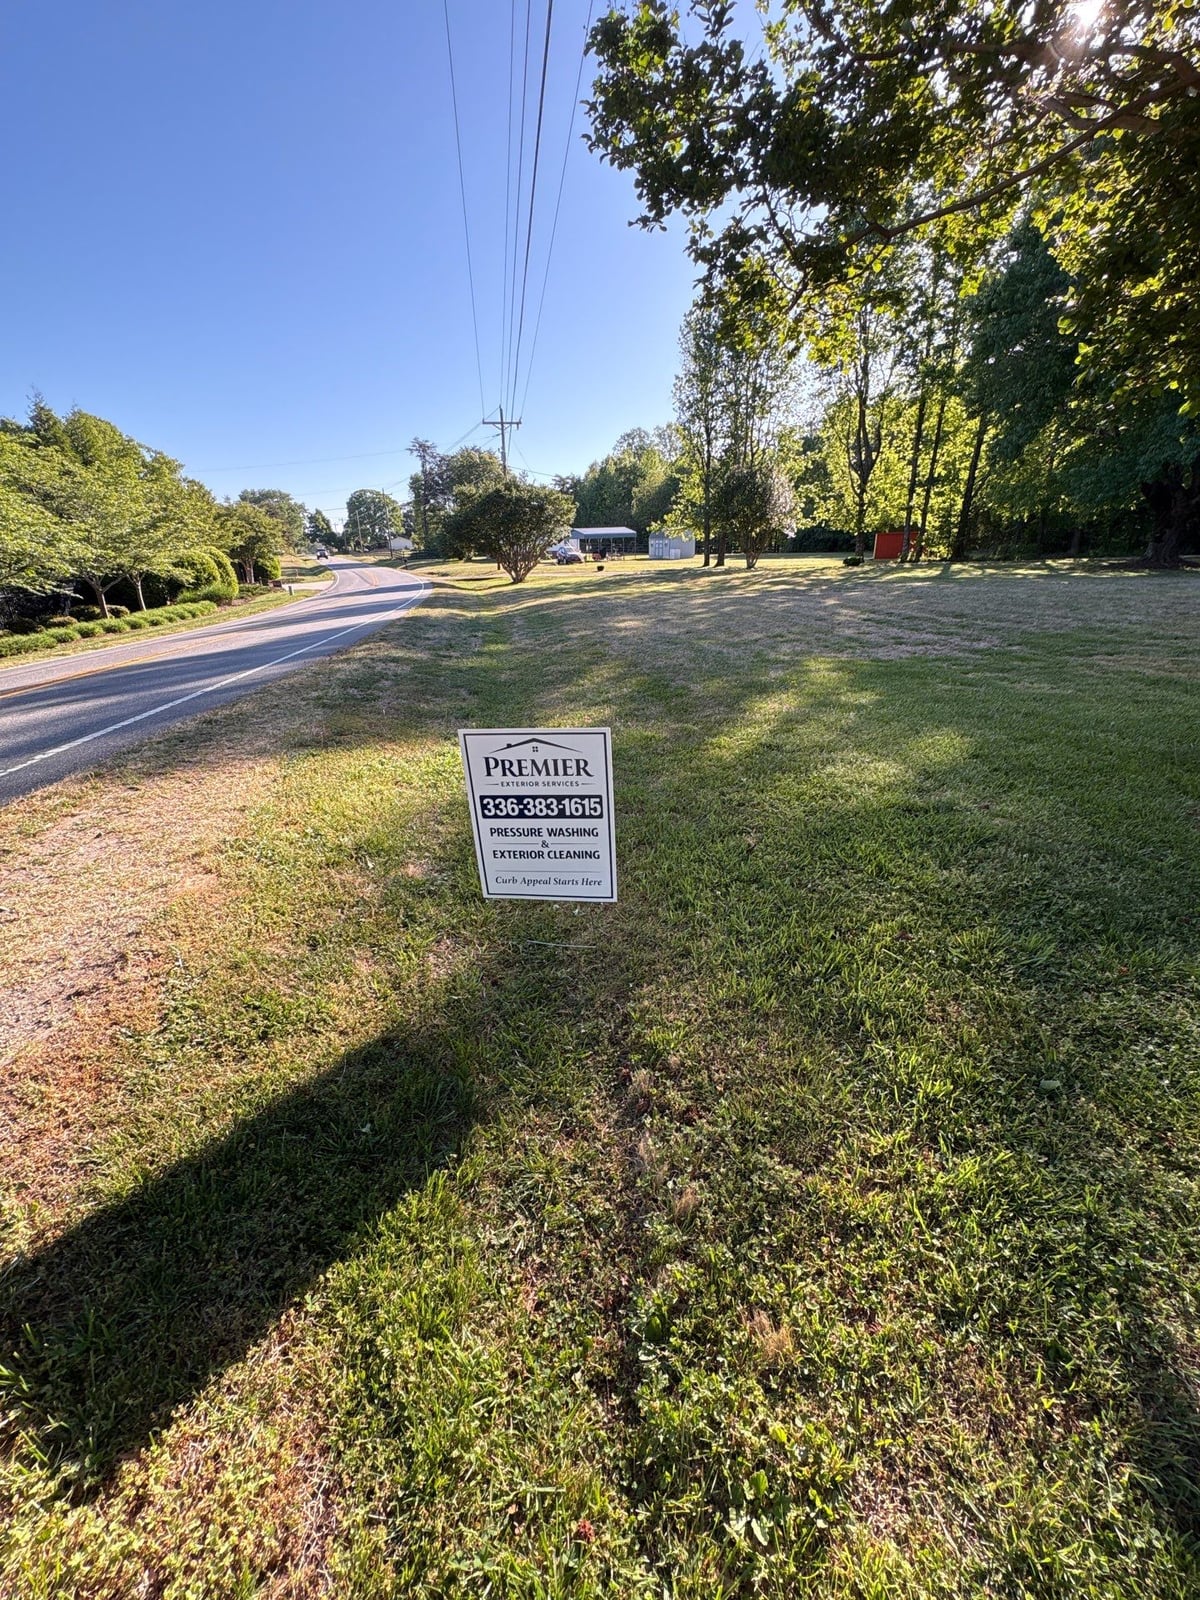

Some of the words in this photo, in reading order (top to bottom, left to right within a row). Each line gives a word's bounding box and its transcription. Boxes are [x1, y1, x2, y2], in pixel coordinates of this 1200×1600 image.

[483, 756, 595, 778] PREMIER
[482, 797, 602, 816] 336-383-1615
[490, 827, 544, 837] PRESSURE
[546, 827, 599, 837] WASHING
[540, 840, 550, 848] &
[493, 850, 545, 860] EXTERIOR
[547, 850, 601, 860] CLEANING
[495, 876, 518, 884] Curb
[520, 876, 551, 887] Appeal
[553, 877, 579, 886] Starts
[581, 877, 602, 886] Here
